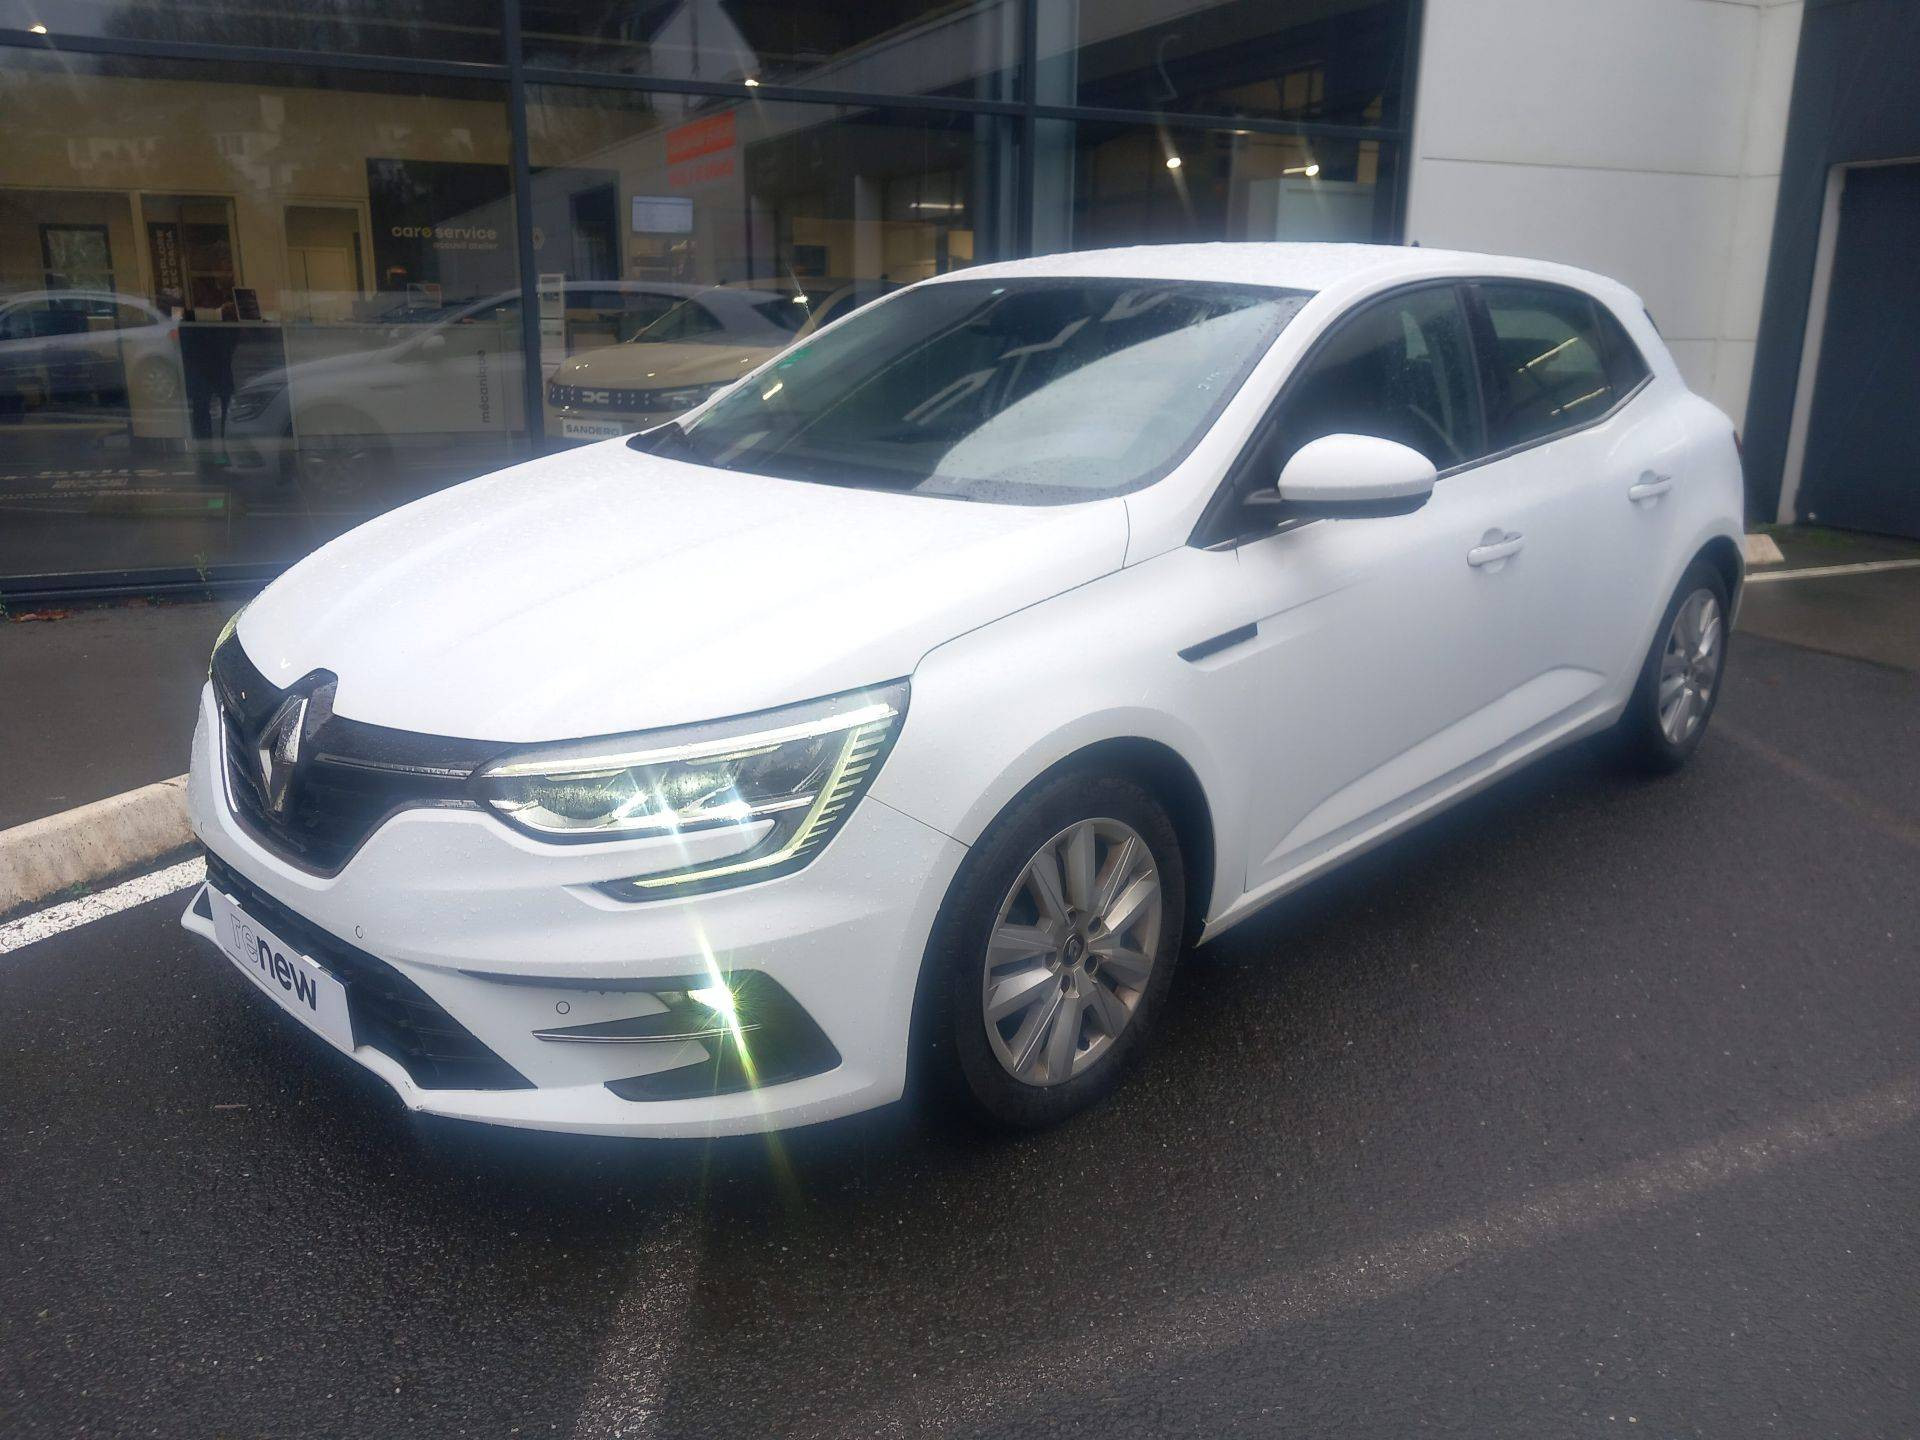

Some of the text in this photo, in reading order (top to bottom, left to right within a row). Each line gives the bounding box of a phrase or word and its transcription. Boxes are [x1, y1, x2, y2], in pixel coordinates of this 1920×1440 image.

[391, 224, 497, 240] care service
[477, 349, 491, 424] mécanique
[565, 424, 619, 436] SANDERO
[229, 913, 317, 1011] renew
